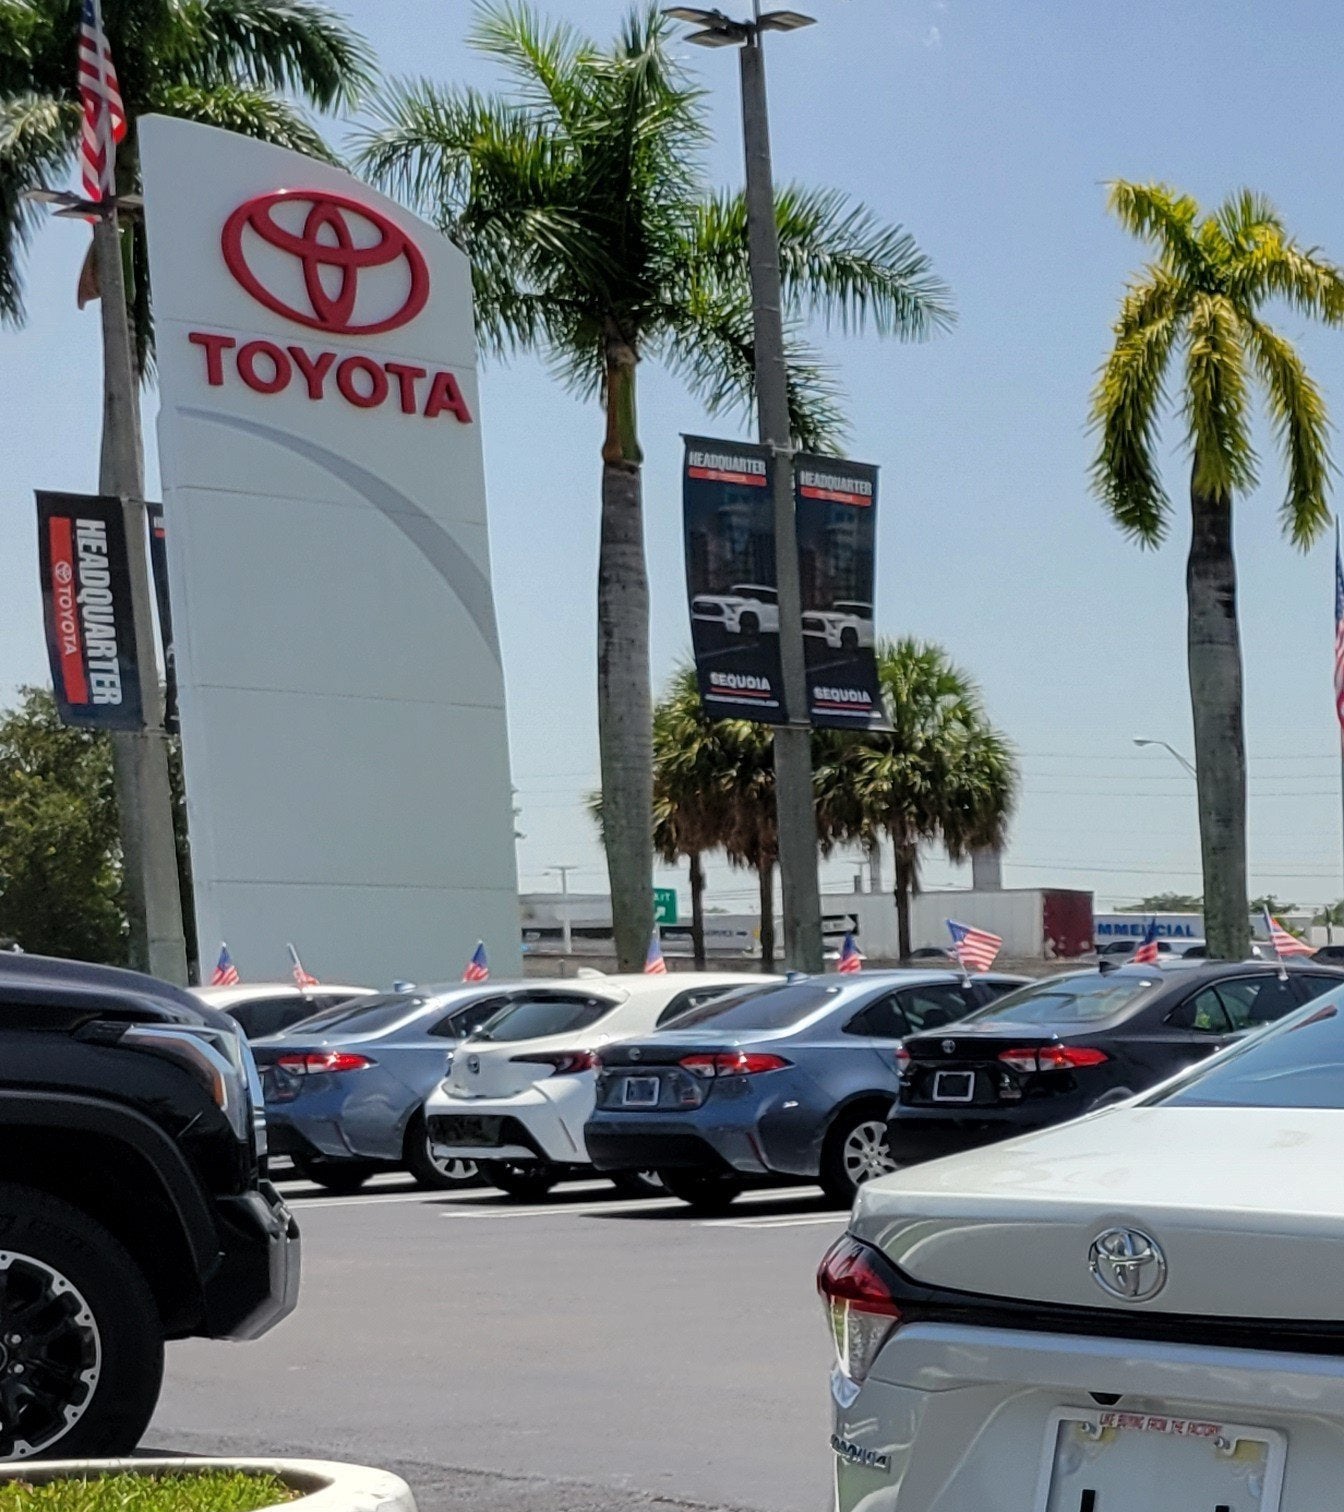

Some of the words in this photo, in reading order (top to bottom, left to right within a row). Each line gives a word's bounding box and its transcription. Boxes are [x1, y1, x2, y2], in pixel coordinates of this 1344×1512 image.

[188, 331, 474, 424] TOYOTA
[688, 451, 767, 476] HEADQUARTER
[800, 470, 872, 497] HEADQUARTER
[58, 585, 77, 657] TOYOTA
[76, 517, 123, 705] HEADQUARTER
[709, 671, 771, 691] SEQUOIA
[813, 686, 872, 704] SEQUOIA
